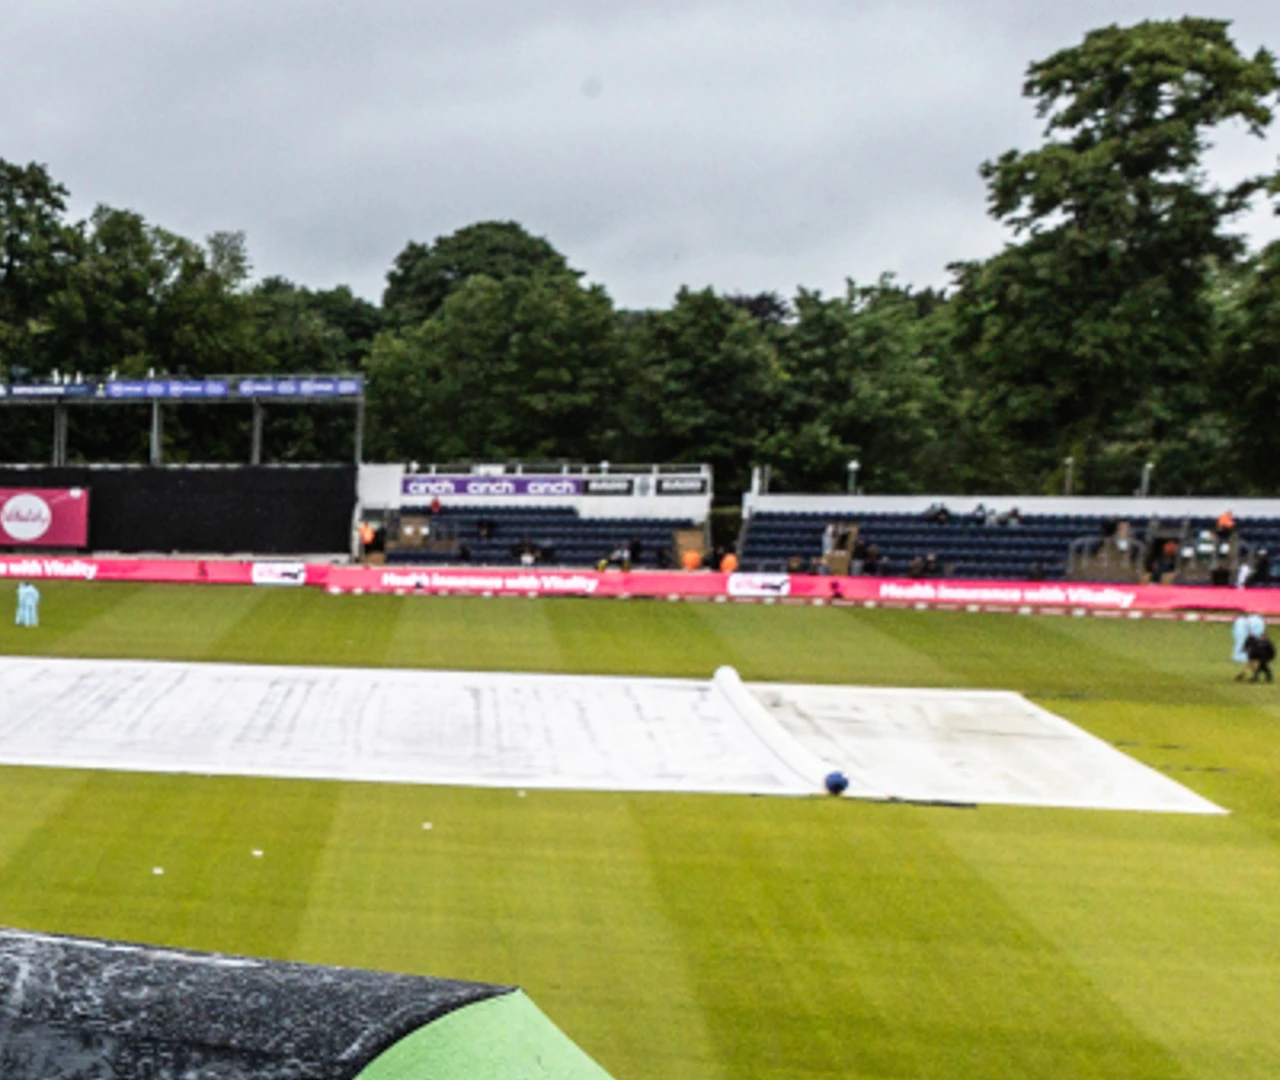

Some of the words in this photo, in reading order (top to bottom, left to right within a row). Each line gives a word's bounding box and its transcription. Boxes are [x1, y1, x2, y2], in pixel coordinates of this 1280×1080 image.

[409, 478, 455, 493] cinch
[467, 478, 514, 493] cinch
[527, 479, 575, 494] cinch
[9, 560, 42, 575] with
[44, 560, 98, 580] Vitality
[382, 572, 430, 587] Health
[505, 575, 540, 589] with
[541, 576, 599, 593] Vitality
[880, 583, 935, 599] Health
[1024, 587, 1065, 603] with
[1067, 588, 1137, 608] Vitality
